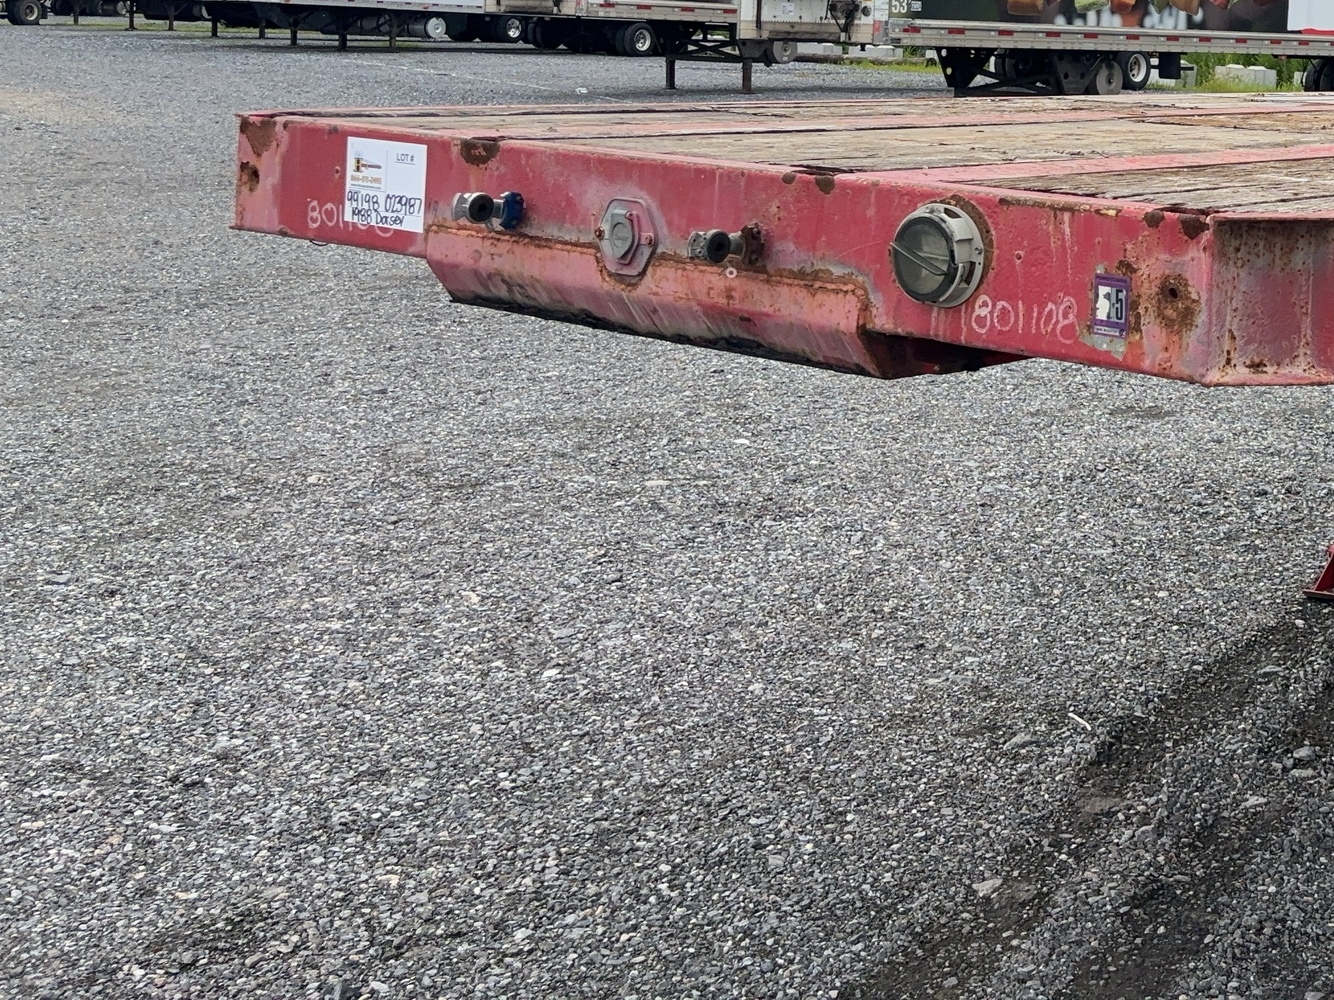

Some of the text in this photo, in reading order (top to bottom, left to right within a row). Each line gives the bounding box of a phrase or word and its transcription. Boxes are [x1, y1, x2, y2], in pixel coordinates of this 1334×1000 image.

[396, 153, 410, 162] LOT
[347, 190, 422, 216] 99198 023987
[352, 207, 372, 224] 1988
[971, 294, 1080, 344] 801108
